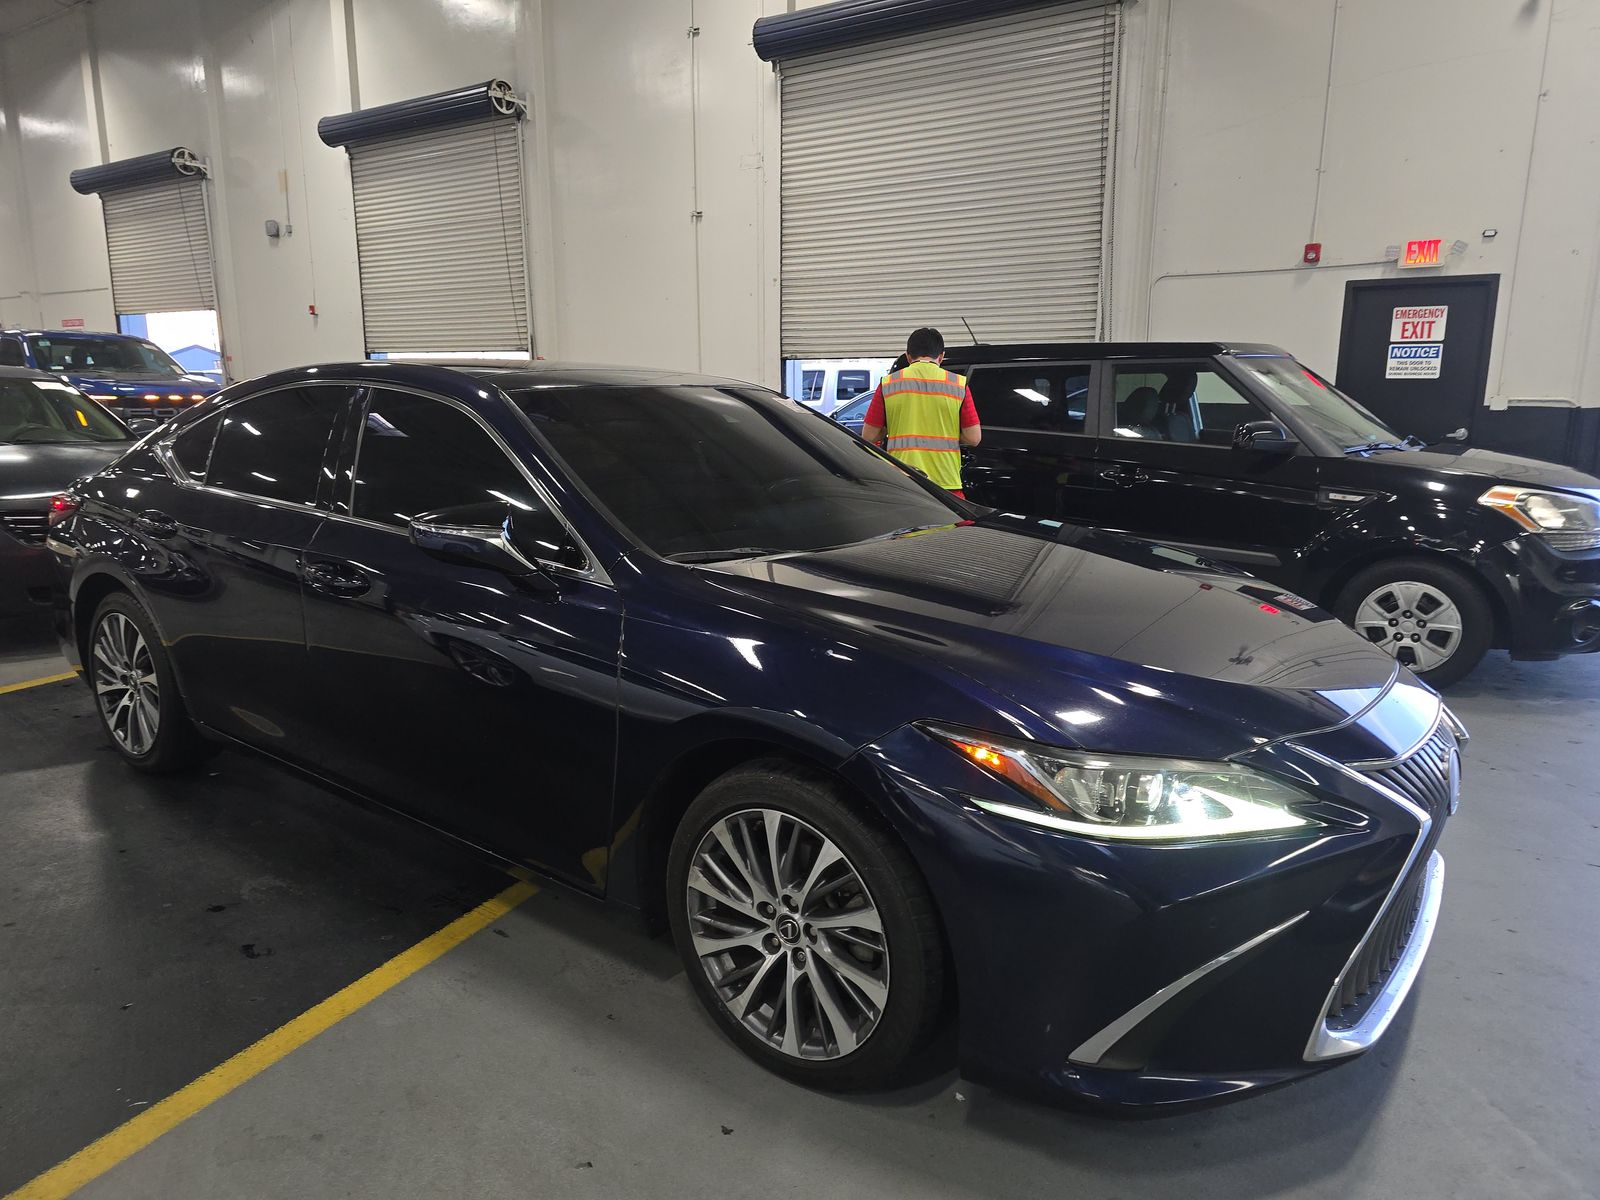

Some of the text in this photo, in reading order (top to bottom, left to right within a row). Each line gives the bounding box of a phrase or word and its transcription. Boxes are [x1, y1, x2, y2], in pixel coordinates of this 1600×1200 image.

[1406, 239, 1441, 264] EXIT
[1394, 308, 1445, 319] EMERGENCY
[1400, 321, 1436, 339] EXIT
[1391, 347, 1439, 358] NOTICE
